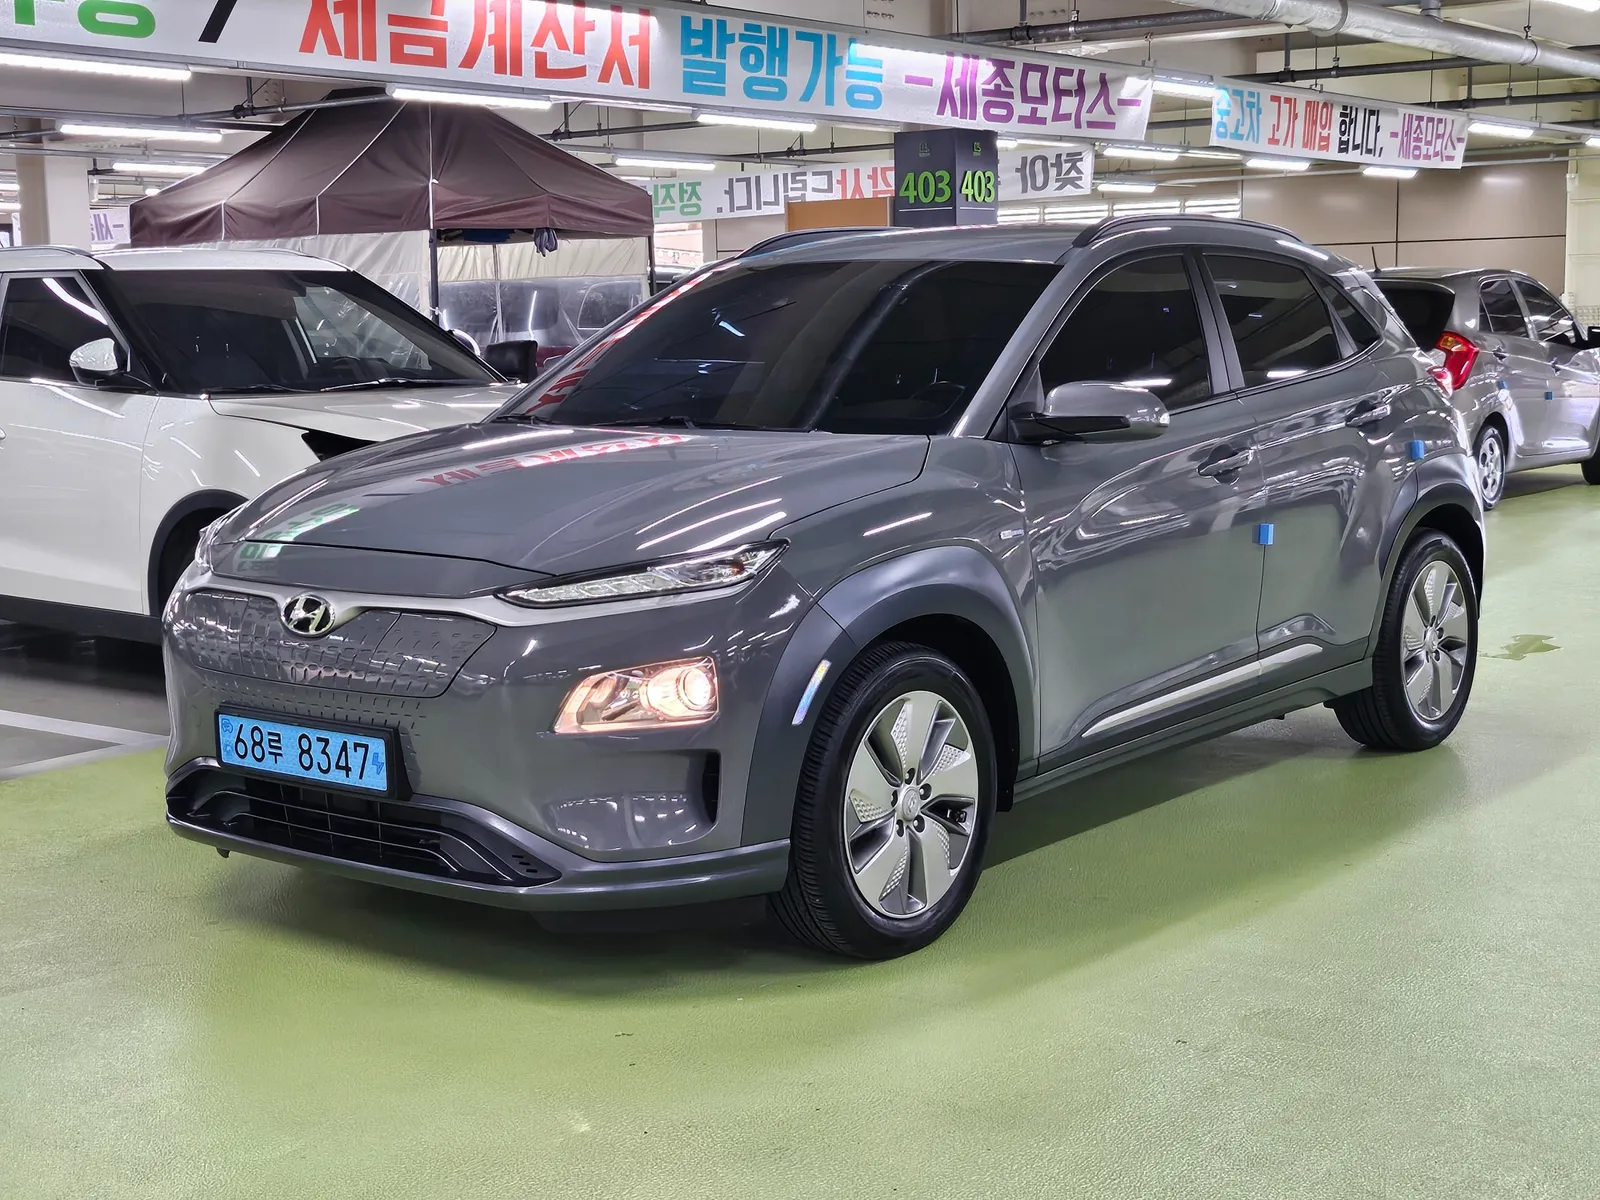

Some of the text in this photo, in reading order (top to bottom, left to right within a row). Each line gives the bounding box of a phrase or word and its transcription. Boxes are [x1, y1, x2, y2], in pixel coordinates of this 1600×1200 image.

[298, 0, 650, 90] 세금계산서
[680, 15, 884, 110] 발행가능
[1215, 86, 1263, 144] 중고차
[1267, 94, 1299, 149] 고가
[1302, 100, 1334, 153] 매입
[899, 170, 952, 204] 403
[961, 170, 995, 203] 403
[234, 723, 370, 780] 68루 8347
